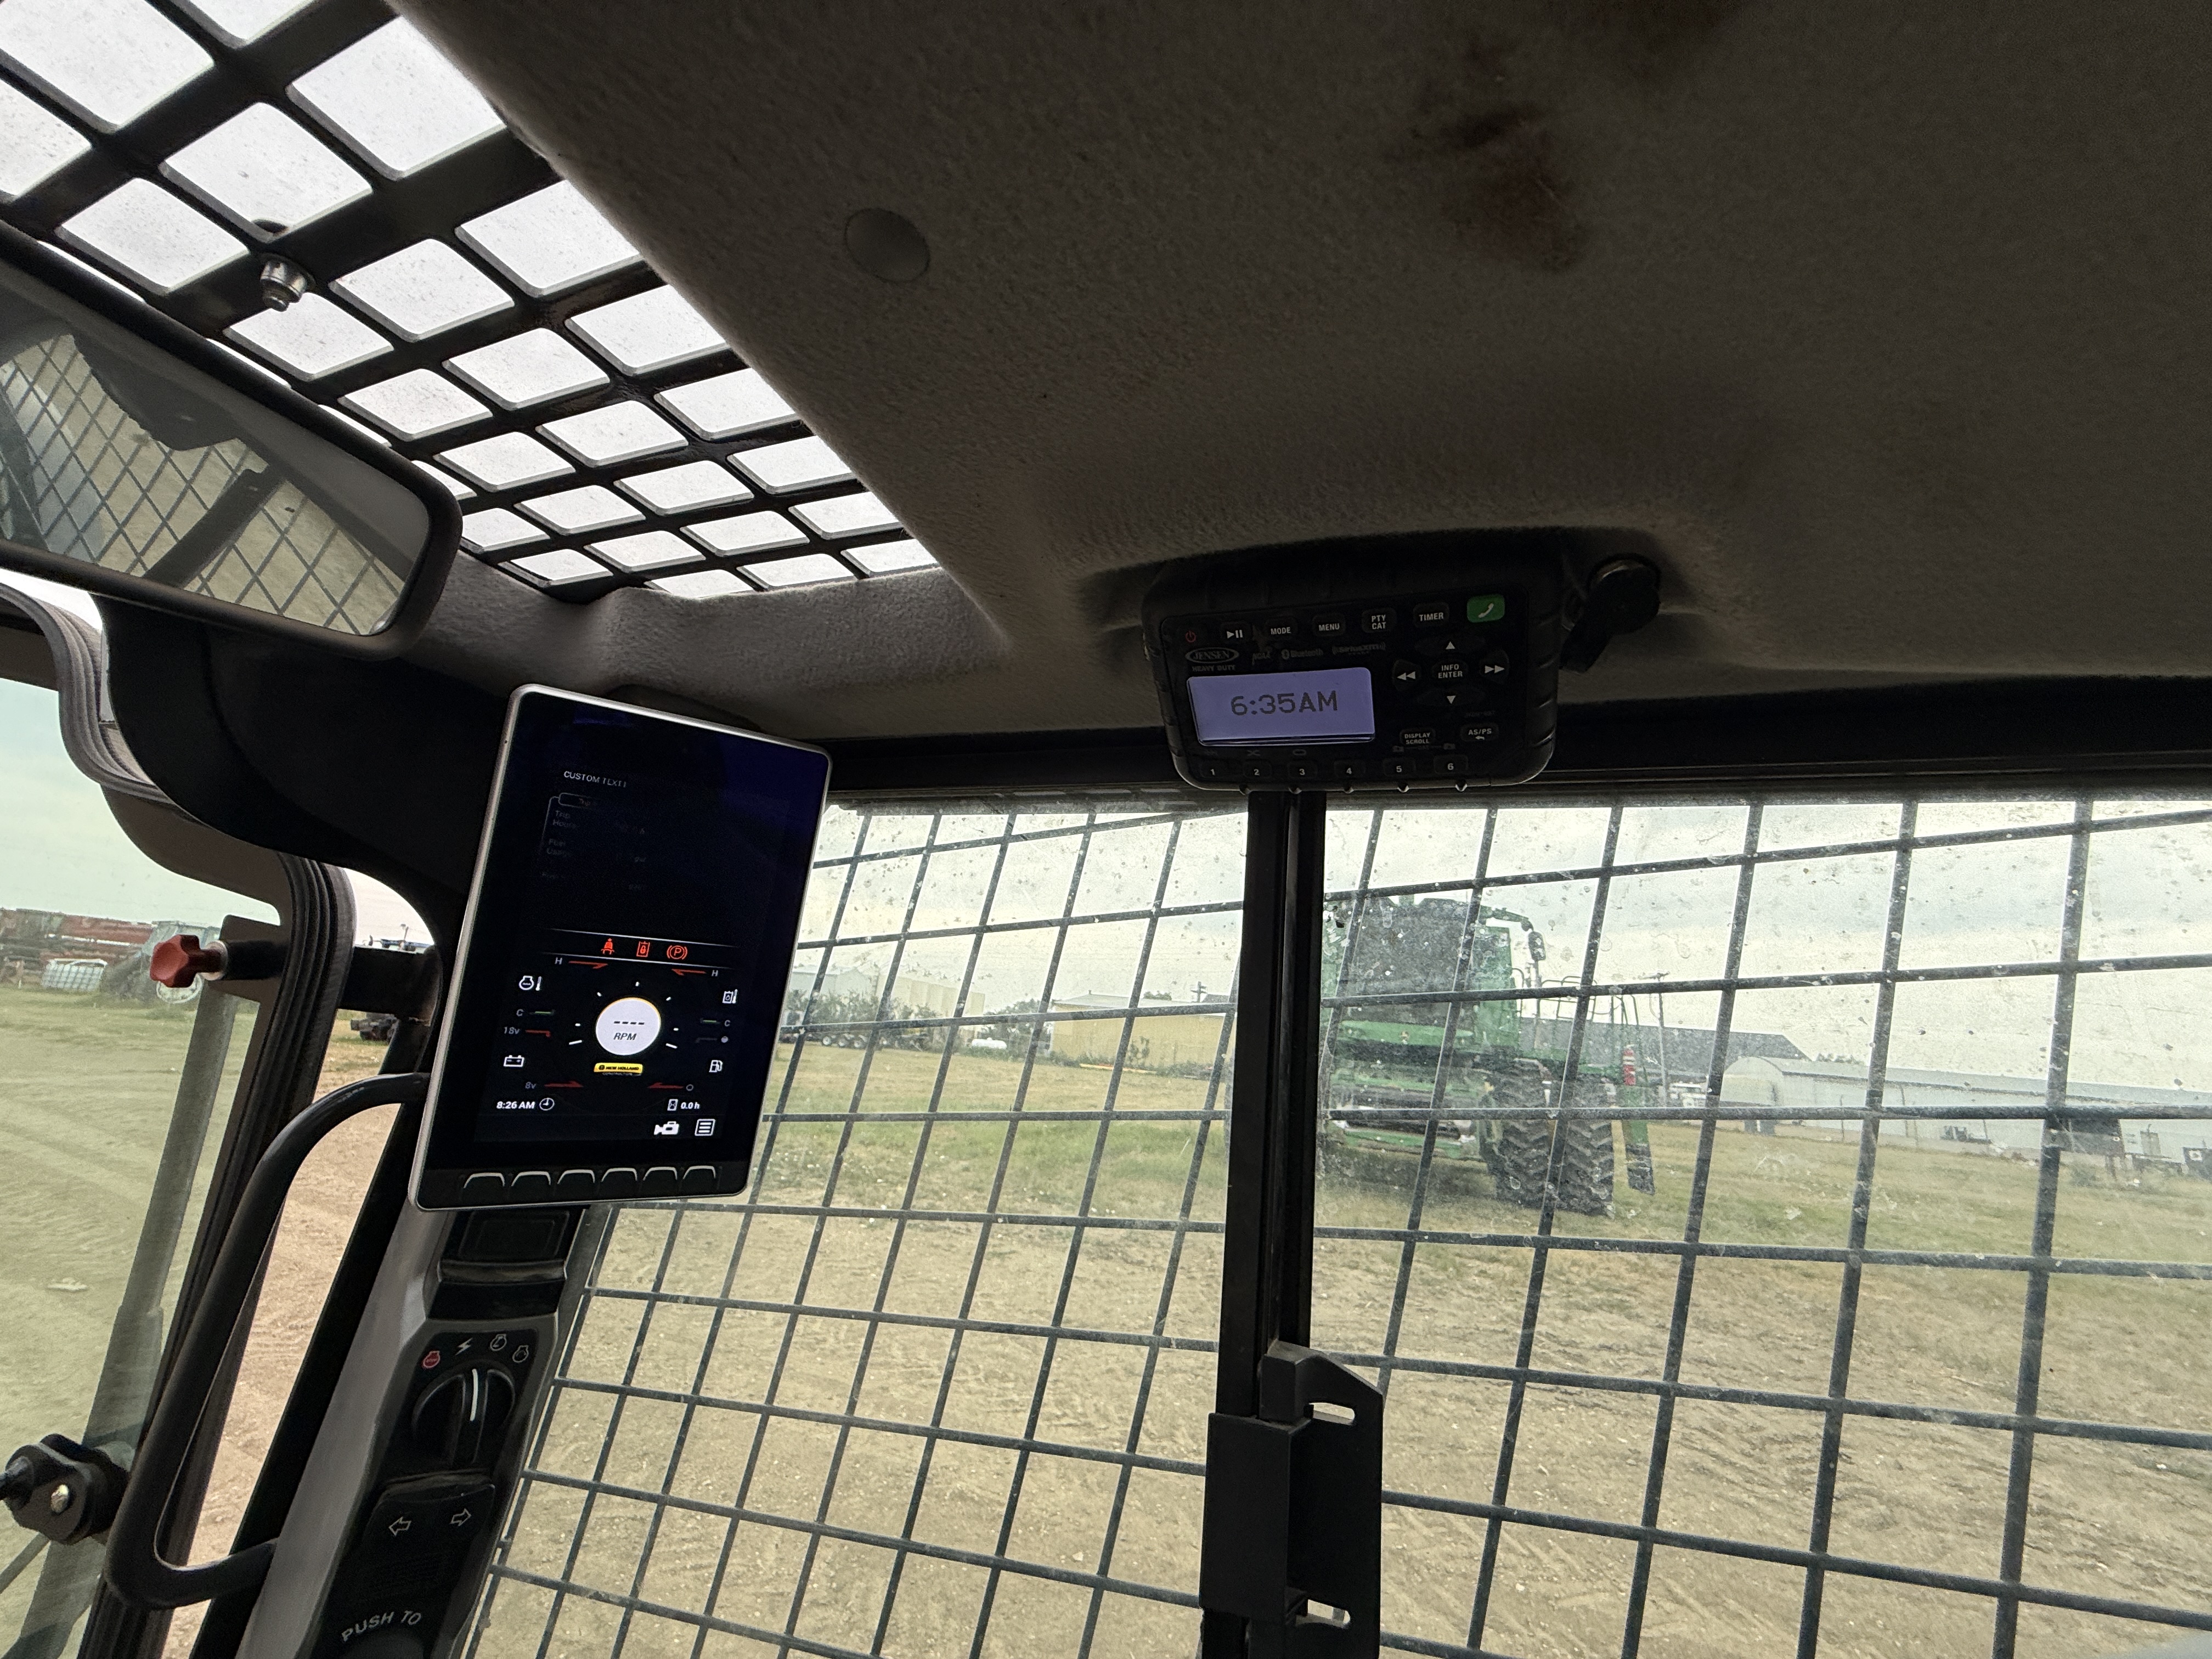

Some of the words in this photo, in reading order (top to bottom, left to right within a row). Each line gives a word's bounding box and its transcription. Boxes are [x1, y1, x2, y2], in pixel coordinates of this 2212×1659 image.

[1419, 612, 1444, 621] TIMER
[1270, 627, 1291, 635] MODE
[1318, 623, 1340, 631] MENU
[1193, 650, 1230, 660] JENSEN
[1437, 670, 1463, 679] ENTER
[1231, 690, 1339, 716] 6:35AM
[1468, 727, 1492, 736] AS/PS
[1210, 768, 1216, 776] 1
[1254, 768, 1260, 776] 2
[1299, 768, 1305, 776] 3
[1346, 767, 1352, 775] 4
[563, 770, 600, 783] CUSTOM
[504, 1026, 520, 1035] 18v
[613, 1032, 637, 1041] RPM
[518, 1101, 535, 1109] AM
[693, 1101, 700, 1109] h
[340, 1611, 395, 1642] PUSH
[400, 1610, 422, 1626] TO
